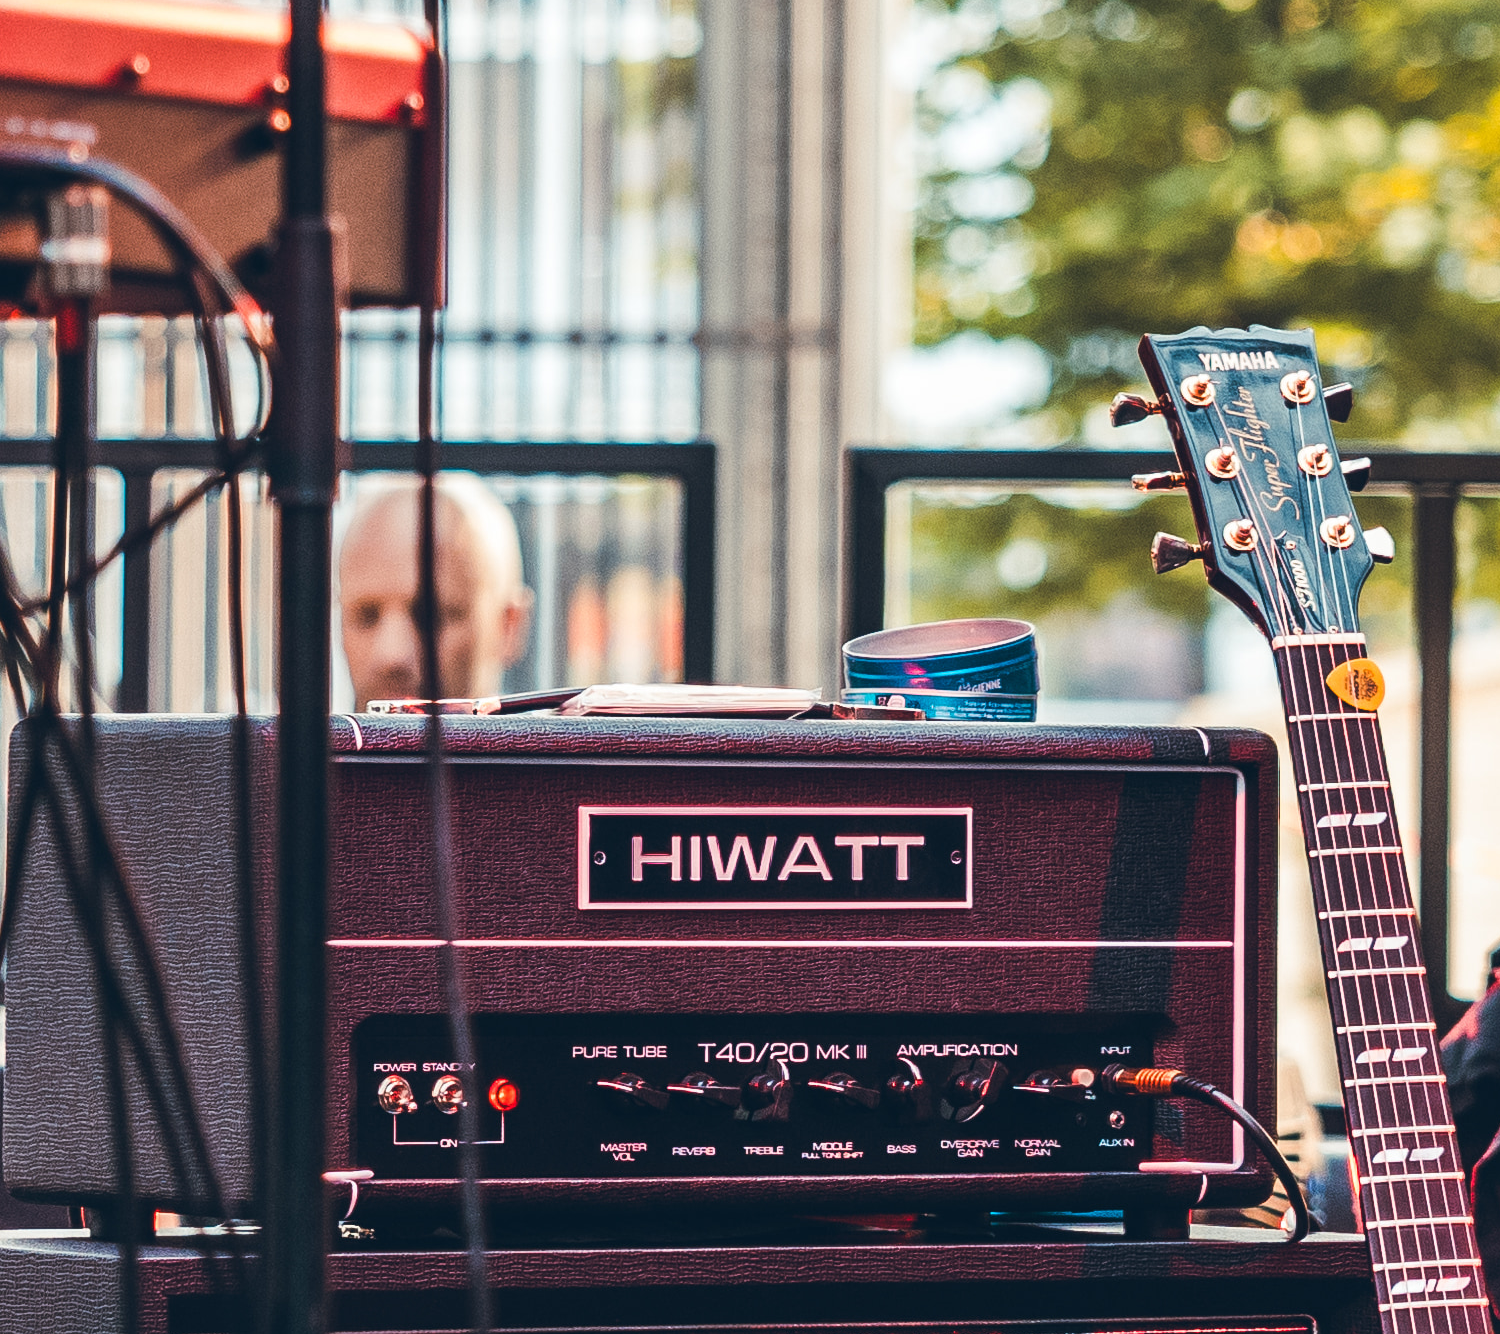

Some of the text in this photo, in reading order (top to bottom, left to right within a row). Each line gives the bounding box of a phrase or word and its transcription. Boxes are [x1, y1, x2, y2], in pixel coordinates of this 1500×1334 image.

[1199, 351, 1279, 371] YAMAHA
[1224, 386, 1300, 520] Super Flighter
[1290, 559, 1316, 612] SF1000
[631, 835, 925, 882] HIWATT
[572, 1043, 1018, 1063] PURE TUBE T40/20 MK III AMPLIFICATION
[1100, 1046, 1132, 1055] INPUT
[373, 1063, 417, 1072] POWER
[422, 1063, 476, 1072] STANDY
[439, 1139, 459, 1148] ON
[600, 1143, 647, 1152] MASTER
[812, 1142, 853, 1151] MIDDLE
[940, 1140, 1000, 1149] OVERDRIVE
[1014, 1139, 1061, 1148] NORMAL
[1099, 1139, 1135, 1147] AUX IN
[672, 1147, 716, 1156] REVERB
[743, 1146, 784, 1155] TREBLE
[886, 1145, 917, 1154] BASS
[957, 1148, 983, 1158] GAIN
[1025, 1148, 1051, 1157] GAIN
[612, 1152, 635, 1161] VOL
[822, 1151, 841, 1159] TONE
